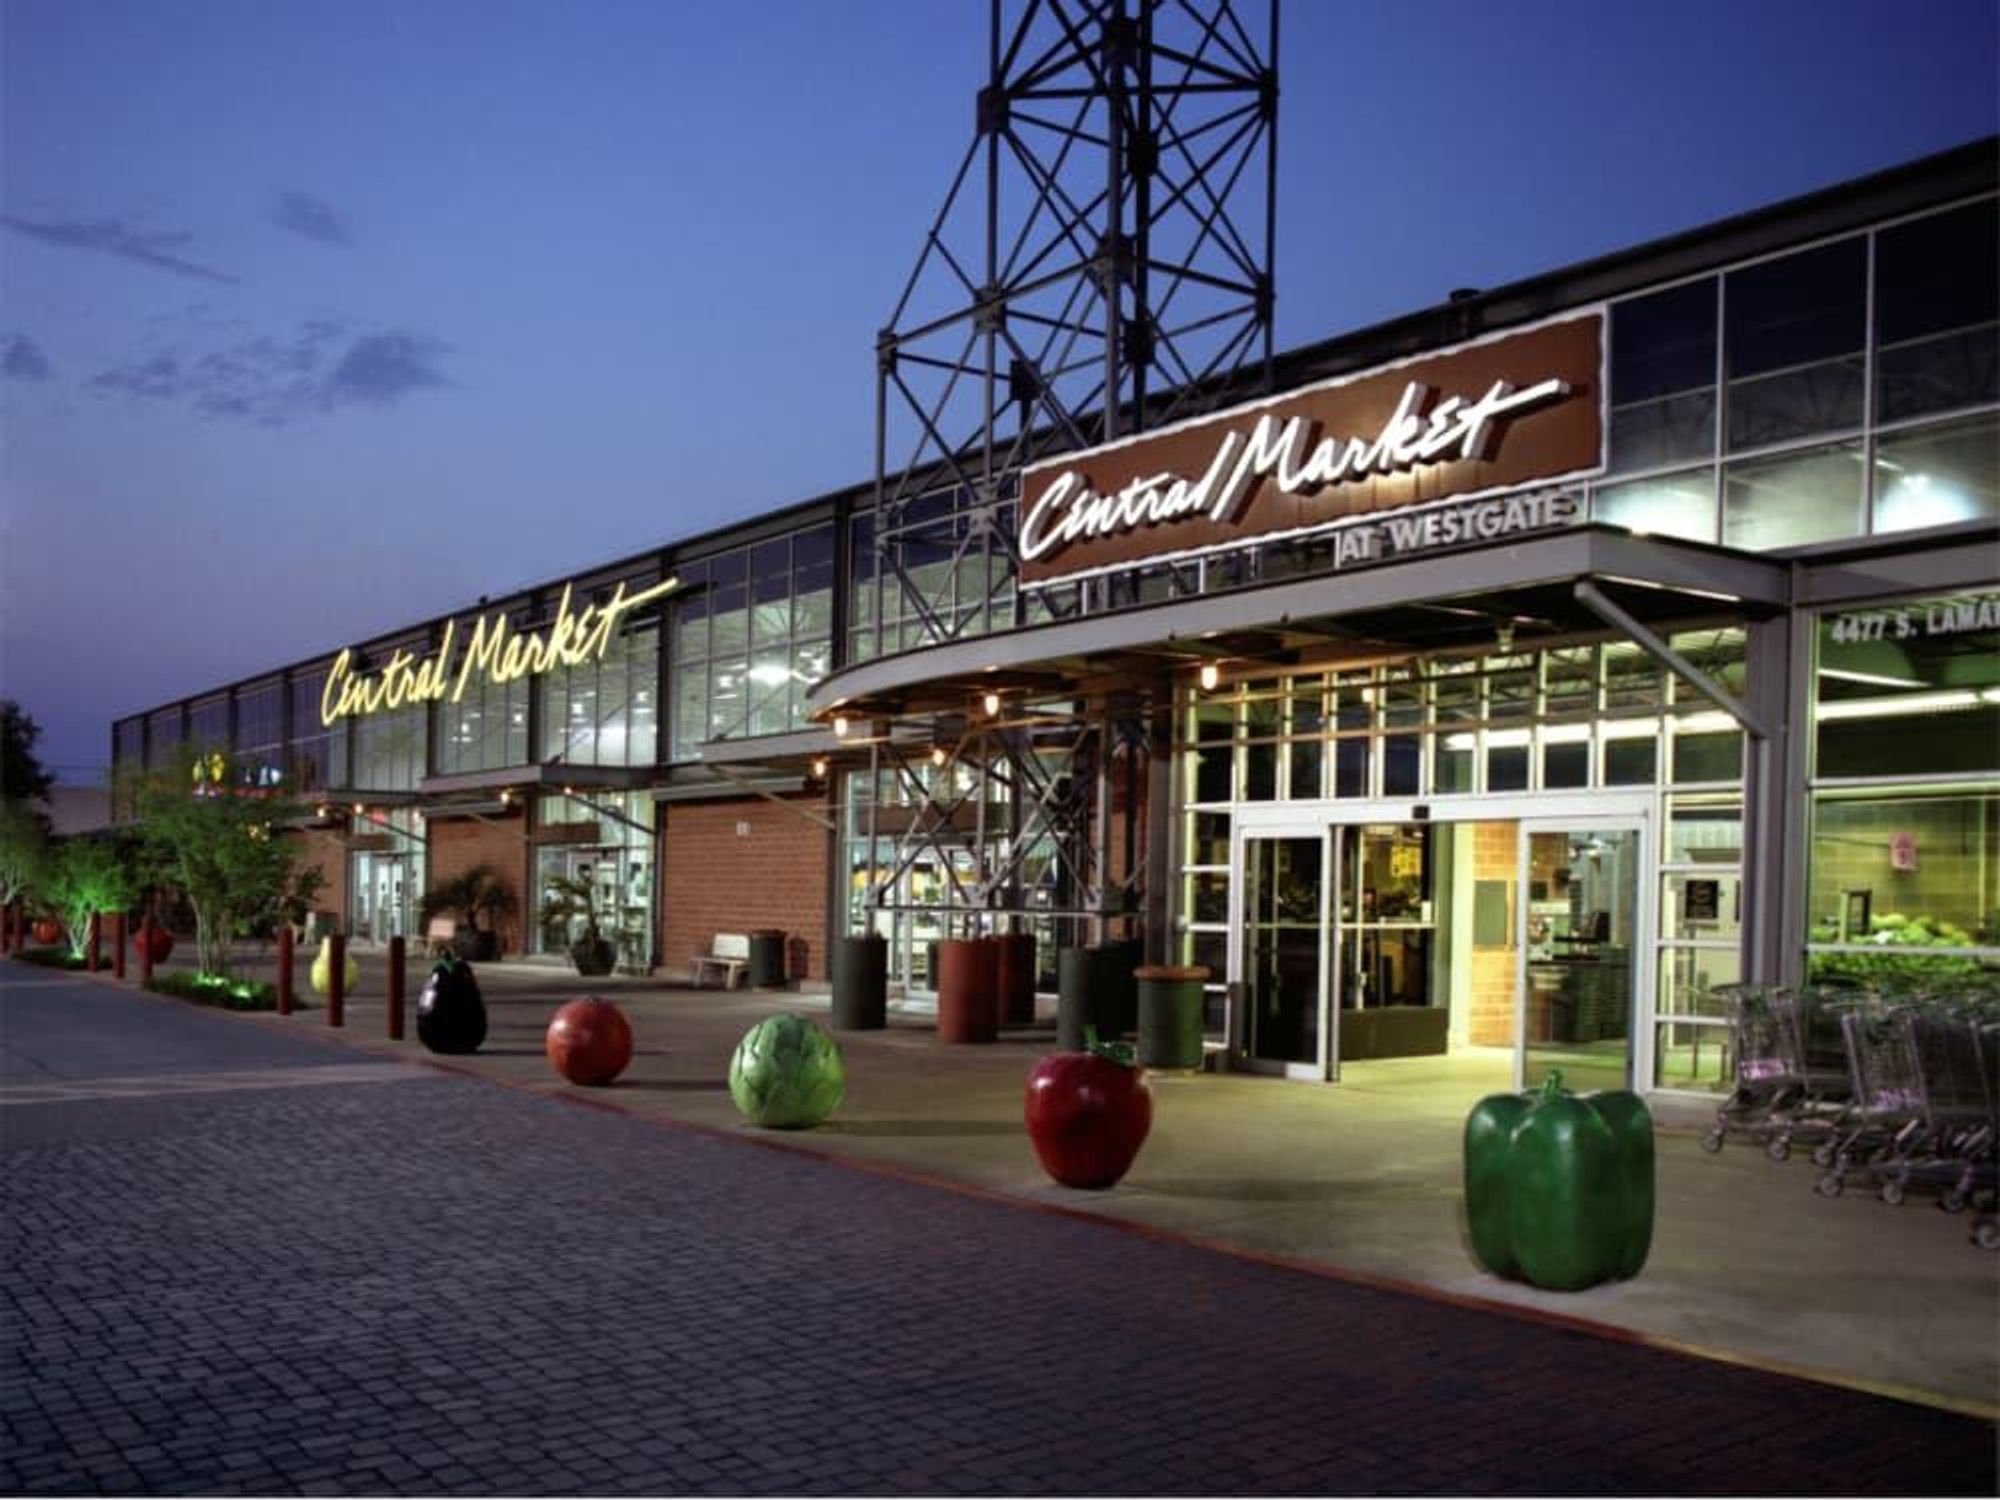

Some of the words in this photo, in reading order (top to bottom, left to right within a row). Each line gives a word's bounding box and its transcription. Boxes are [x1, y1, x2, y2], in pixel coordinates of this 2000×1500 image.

[1019, 430, 1236, 561] Central
[1209, 378, 1568, 521] Market
[1340, 527, 1376, 563] AT
[1384, 488, 1570, 552] WESTGATE
[320, 618, 454, 727] Central
[452, 578, 679, 702] Market
[1831, 614, 1887, 643] 4477
